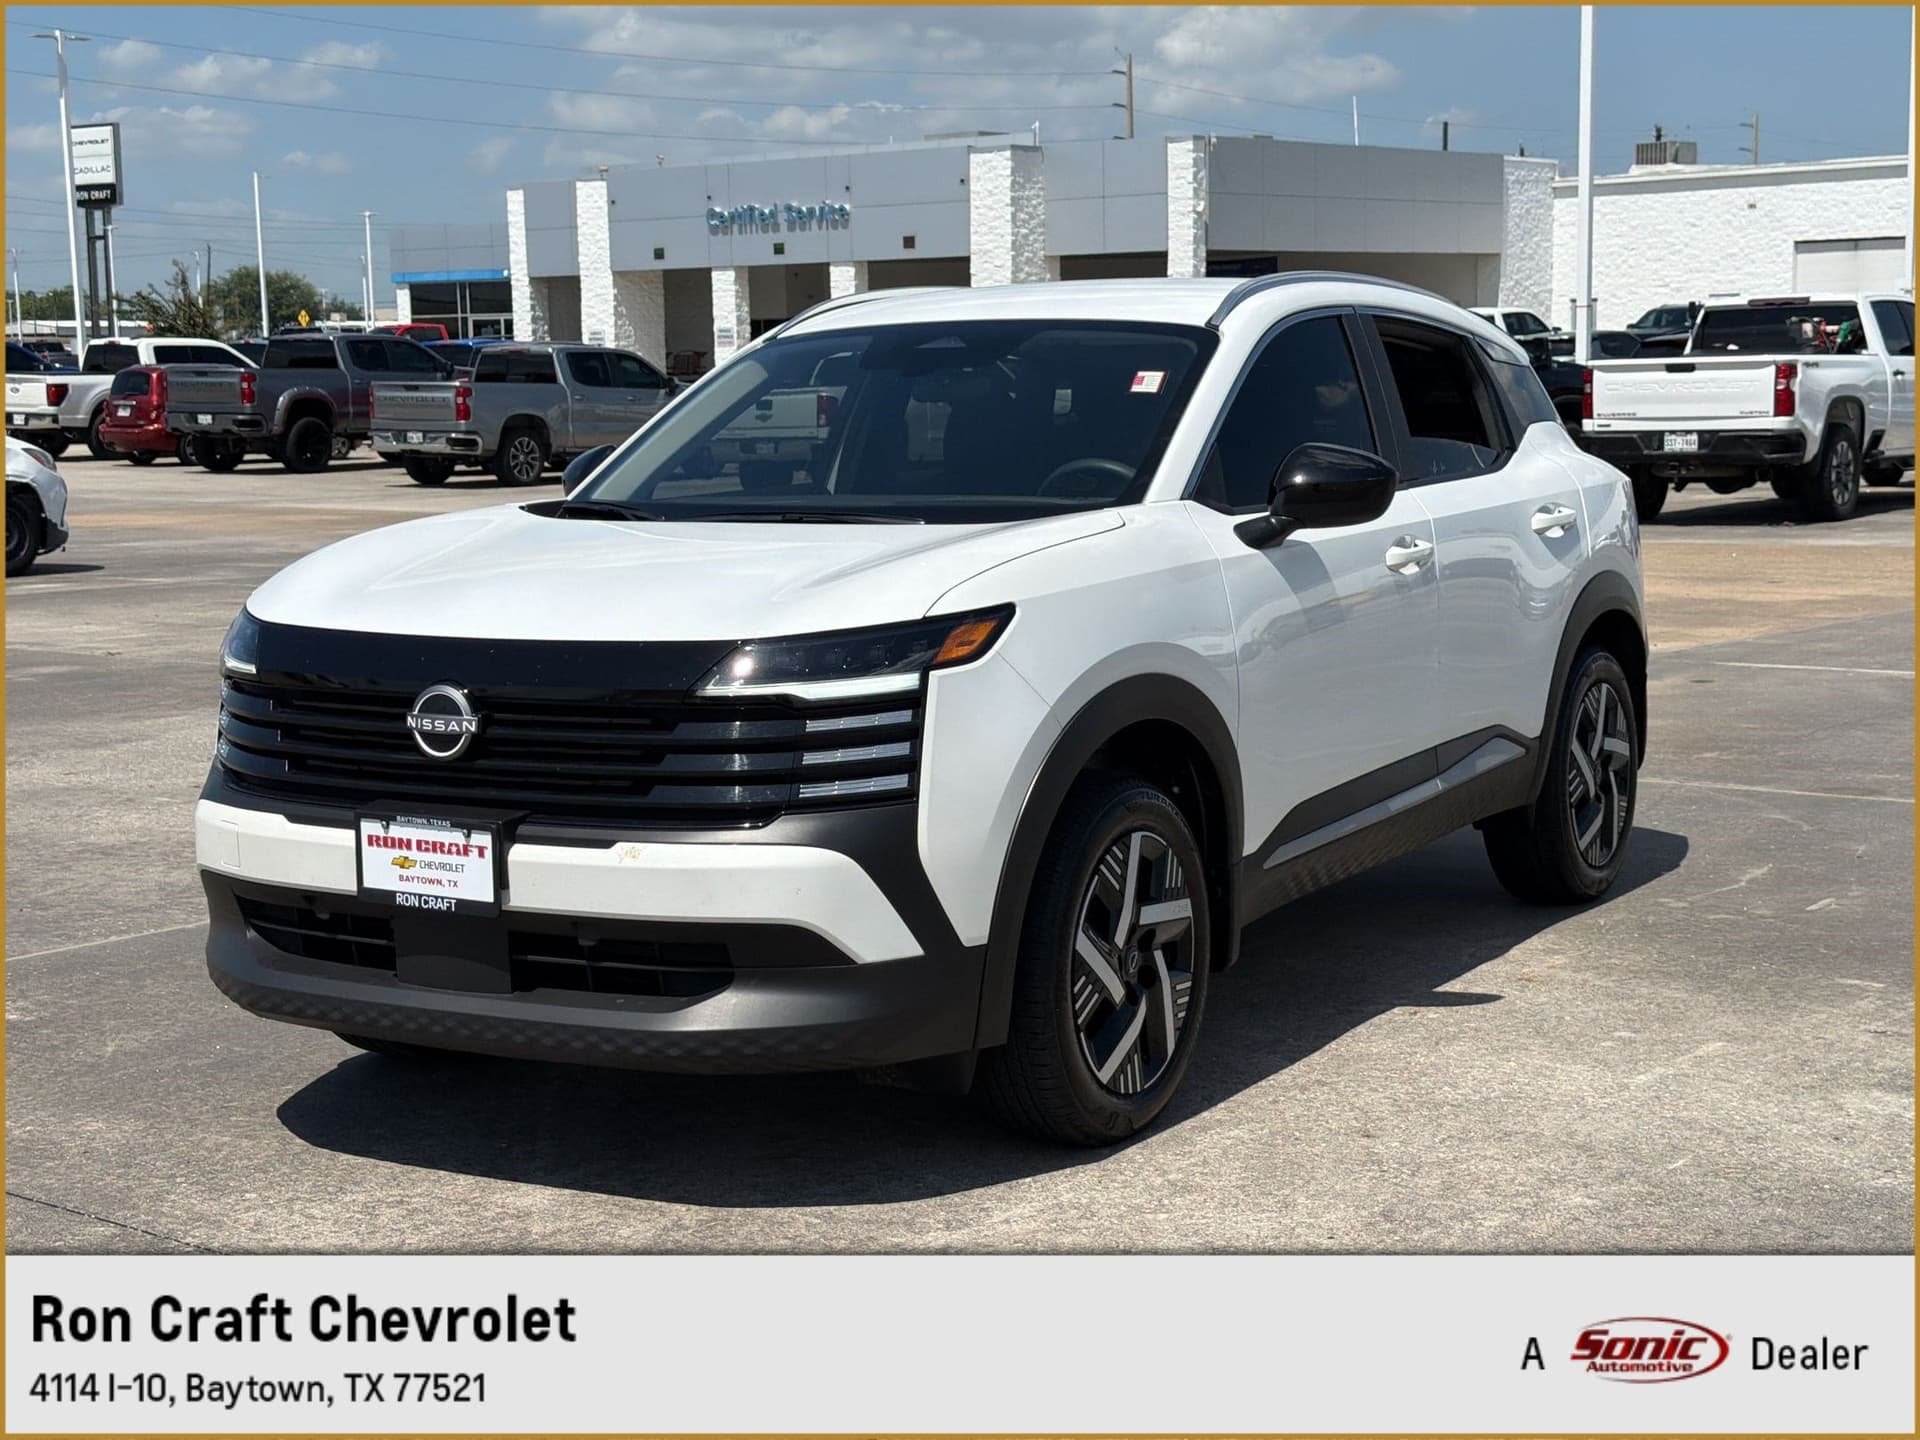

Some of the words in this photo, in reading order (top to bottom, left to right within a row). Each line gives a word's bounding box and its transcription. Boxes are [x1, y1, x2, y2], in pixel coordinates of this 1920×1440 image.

[73, 165, 112, 175] CADILLAC
[90, 189, 111, 200] CRAFT
[706, 203, 778, 226] Certified
[784, 200, 850, 223] Service
[407, 715, 476, 733] NISSAN
[430, 818, 451, 827] TEXAS
[367, 834, 413, 852] RON
[415, 839, 489, 859] CRAFT
[419, 861, 466, 874] CHEVROLET
[398, 874, 446, 888] BAYTOWN,
[447, 879, 459, 889] TX
[395, 893, 420, 908] RON
[421, 896, 457, 912] CRAFT
